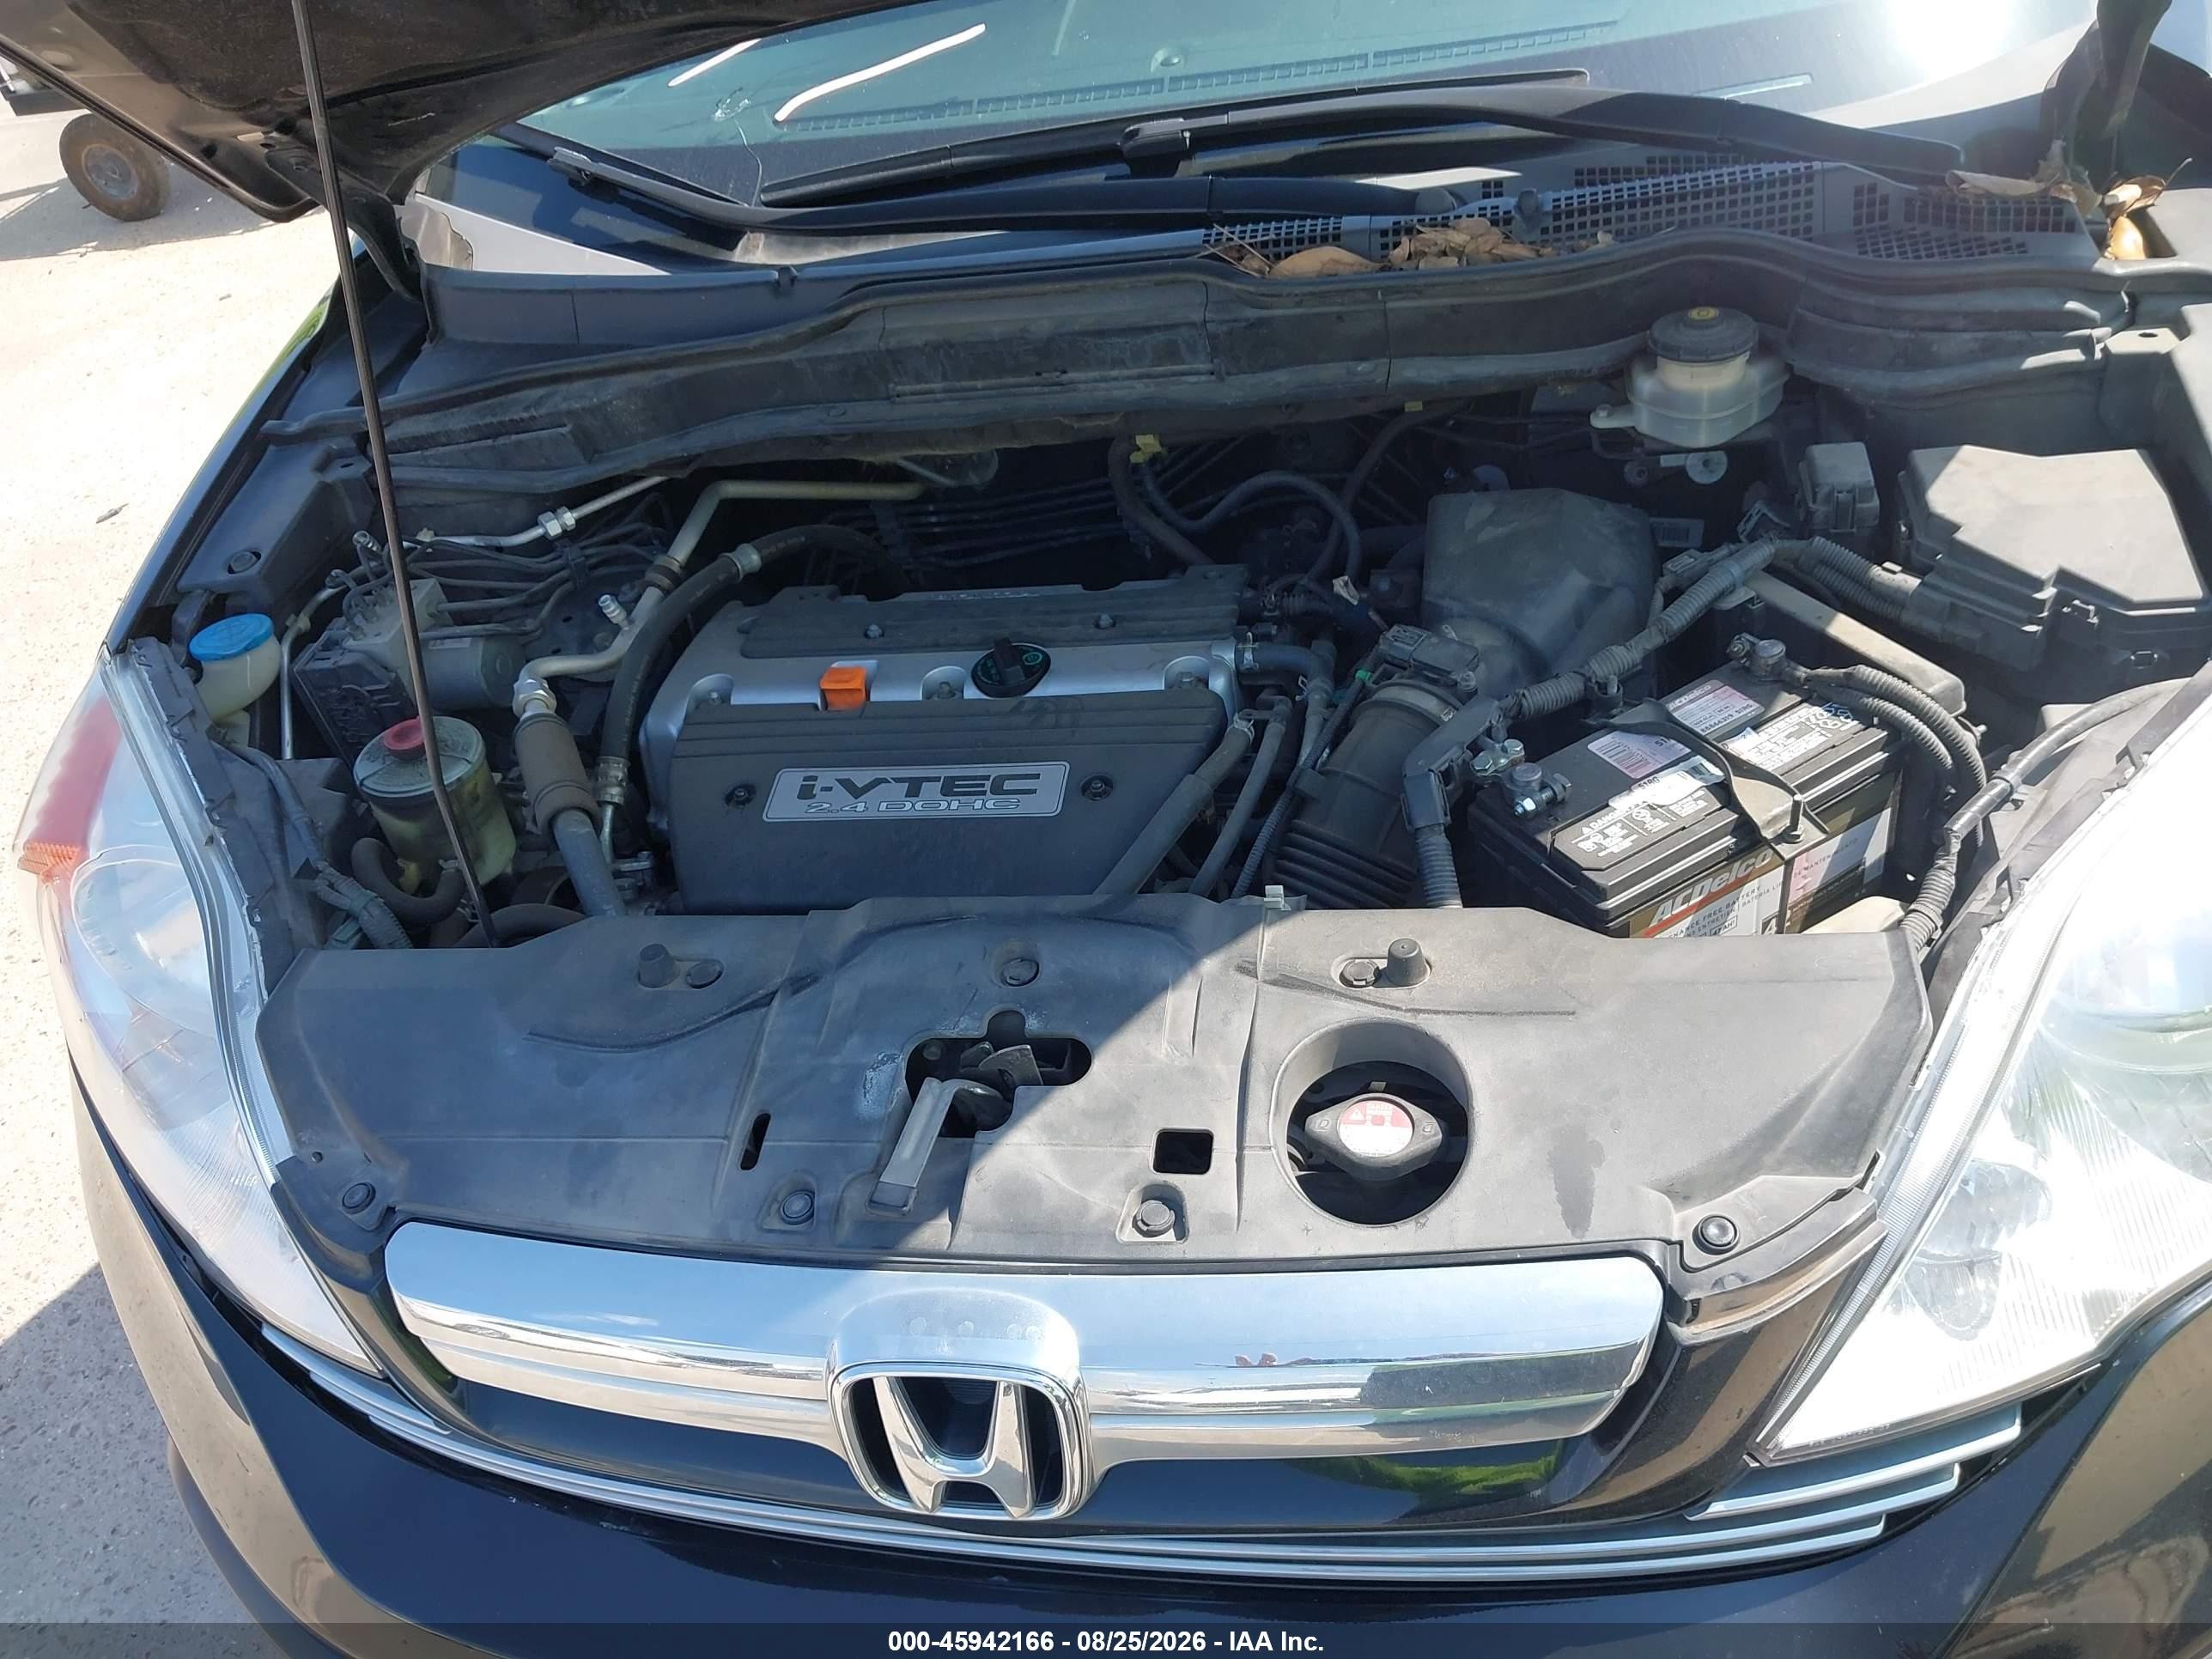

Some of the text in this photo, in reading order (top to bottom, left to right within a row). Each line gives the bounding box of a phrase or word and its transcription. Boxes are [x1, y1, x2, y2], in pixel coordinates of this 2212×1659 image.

[797, 773, 1041, 799] i-VTEC
[805, 796, 1021, 814] 2.4 DOHC
[1648, 848, 1774, 928] ACDelco
